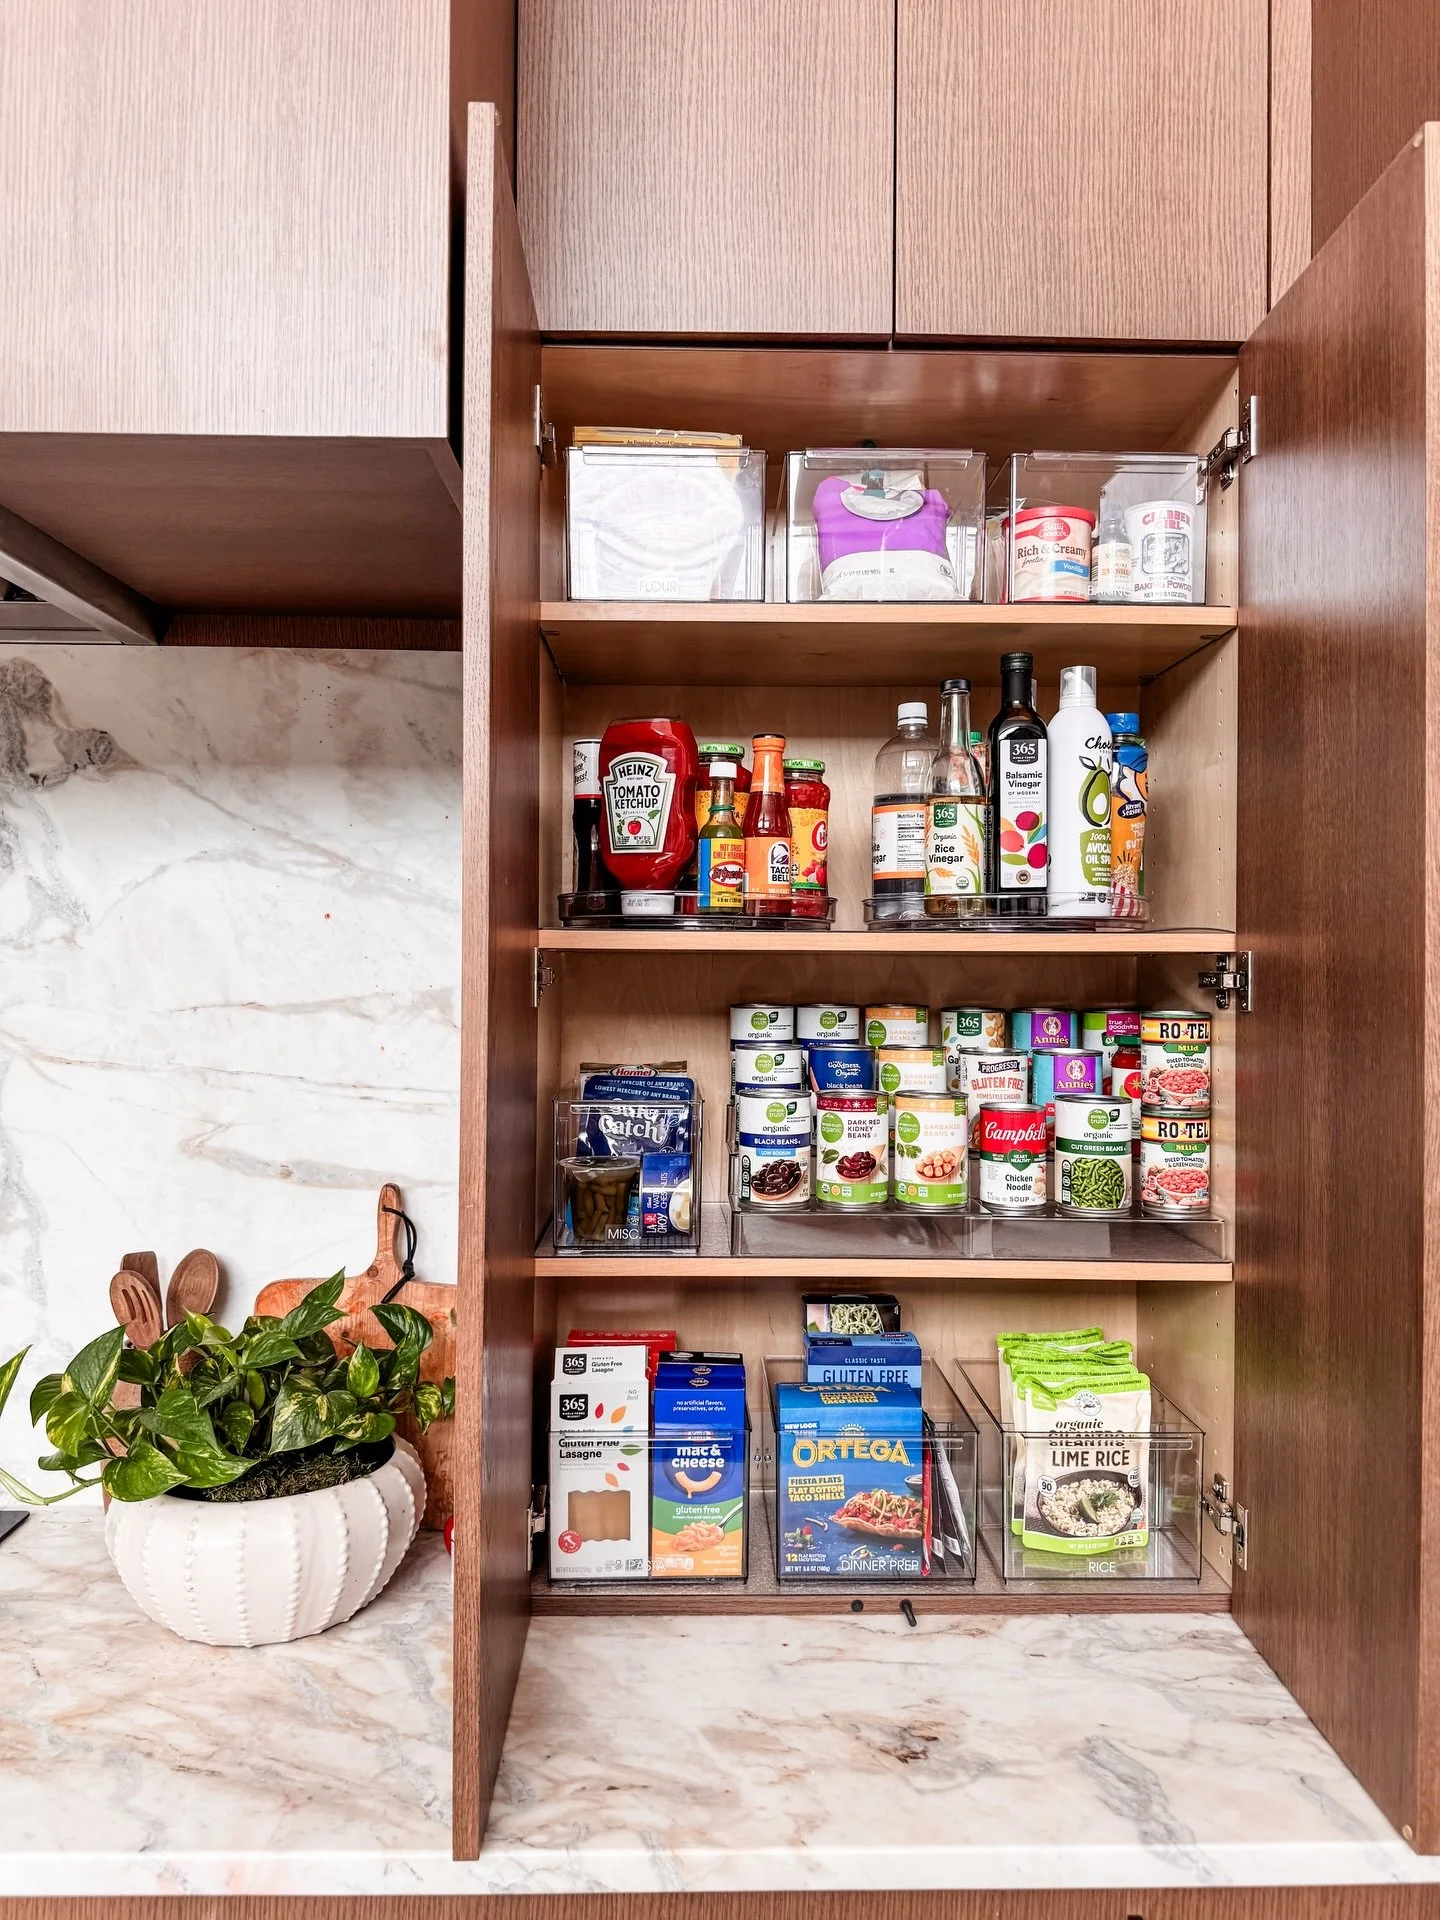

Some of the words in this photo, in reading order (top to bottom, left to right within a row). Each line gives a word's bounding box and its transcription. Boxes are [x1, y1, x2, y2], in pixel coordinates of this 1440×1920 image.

[1017, 544, 1039, 559] Rich
[1052, 543, 1087, 559] Creamy
[639, 581, 677, 593] FLOUR
[1012, 743, 1036, 756] 365
[618, 764, 654, 778] HEINZ
[1006, 771, 1043, 780] Balsamic
[1009, 780, 1041, 790] Vinegar
[613, 785, 660, 798] TOMATO
[615, 798, 658, 810] KETCHUP
[936, 807, 955, 820] 365
[933, 833, 957, 843] Organic
[935, 844, 955, 853] Rice
[929, 855, 964, 864] Vinegar
[1086, 855, 1099, 864] OIL
[770, 866, 789, 874] TACO
[772, 874, 789, 882] BELL
[959, 1016, 980, 1029] 365
[1109, 1023, 1139, 1032] goodness
[748, 1031, 772, 1039] organic
[816, 1030, 841, 1038] organic
[1034, 1035, 1069, 1045] Annie's
[981, 1061, 1017, 1072] PROGRESSO
[615, 1068, 652, 1076] Hormel
[835, 1068, 858, 1078] Organic
[752, 1074, 778, 1083] organic
[971, 1077, 1005, 1090] GLUTEN
[1008, 1077, 1024, 1091] FREE
[1056, 1080, 1094, 1089] Annie's
[595, 1085, 616, 1093] LOWEST
[617, 1087, 641, 1096] MERCURY
[598, 1114, 668, 1144] Catch
[762, 1125, 790, 1134] organic
[1084, 1131, 1113, 1140] organic
[1084, 1144, 1105, 1152] GREEN
[1175, 1143, 1198, 1151] Mild
[1004, 1174, 1033, 1182] Chicken
[1006, 1183, 1031, 1191] Noodle
[657, 1212, 667, 1234] CHOY
[646, 1224, 656, 1233] LA
[607, 1229, 641, 1240] MISC.
[565, 1357, 585, 1368] 365
[823, 1369, 874, 1383] GLUTEN
[879, 1369, 909, 1384] FREE
[562, 1397, 586, 1412] 365
[1055, 1418, 1103, 1431] organic
[560, 1449, 602, 1460] Lasagne
[677, 1447, 708, 1456] mac
[710, 1444, 721, 1456] &
[793, 1440, 911, 1467] ORTEGA
[1052, 1450, 1089, 1467] LIME
[1095, 1449, 1130, 1467] RICE
[818, 1477, 842, 1485] FLATS
[1041, 1481, 1052, 1491] 90
[814, 1492, 845, 1500] SHELLS
[676, 1505, 703, 1515] gluten
[703, 1505, 720, 1514] free
[786, 1553, 798, 1562] 12
[841, 1559, 887, 1571] DINNER
[889, 1560, 919, 1571] PREP
[1088, 1561, 1116, 1572] RICE
